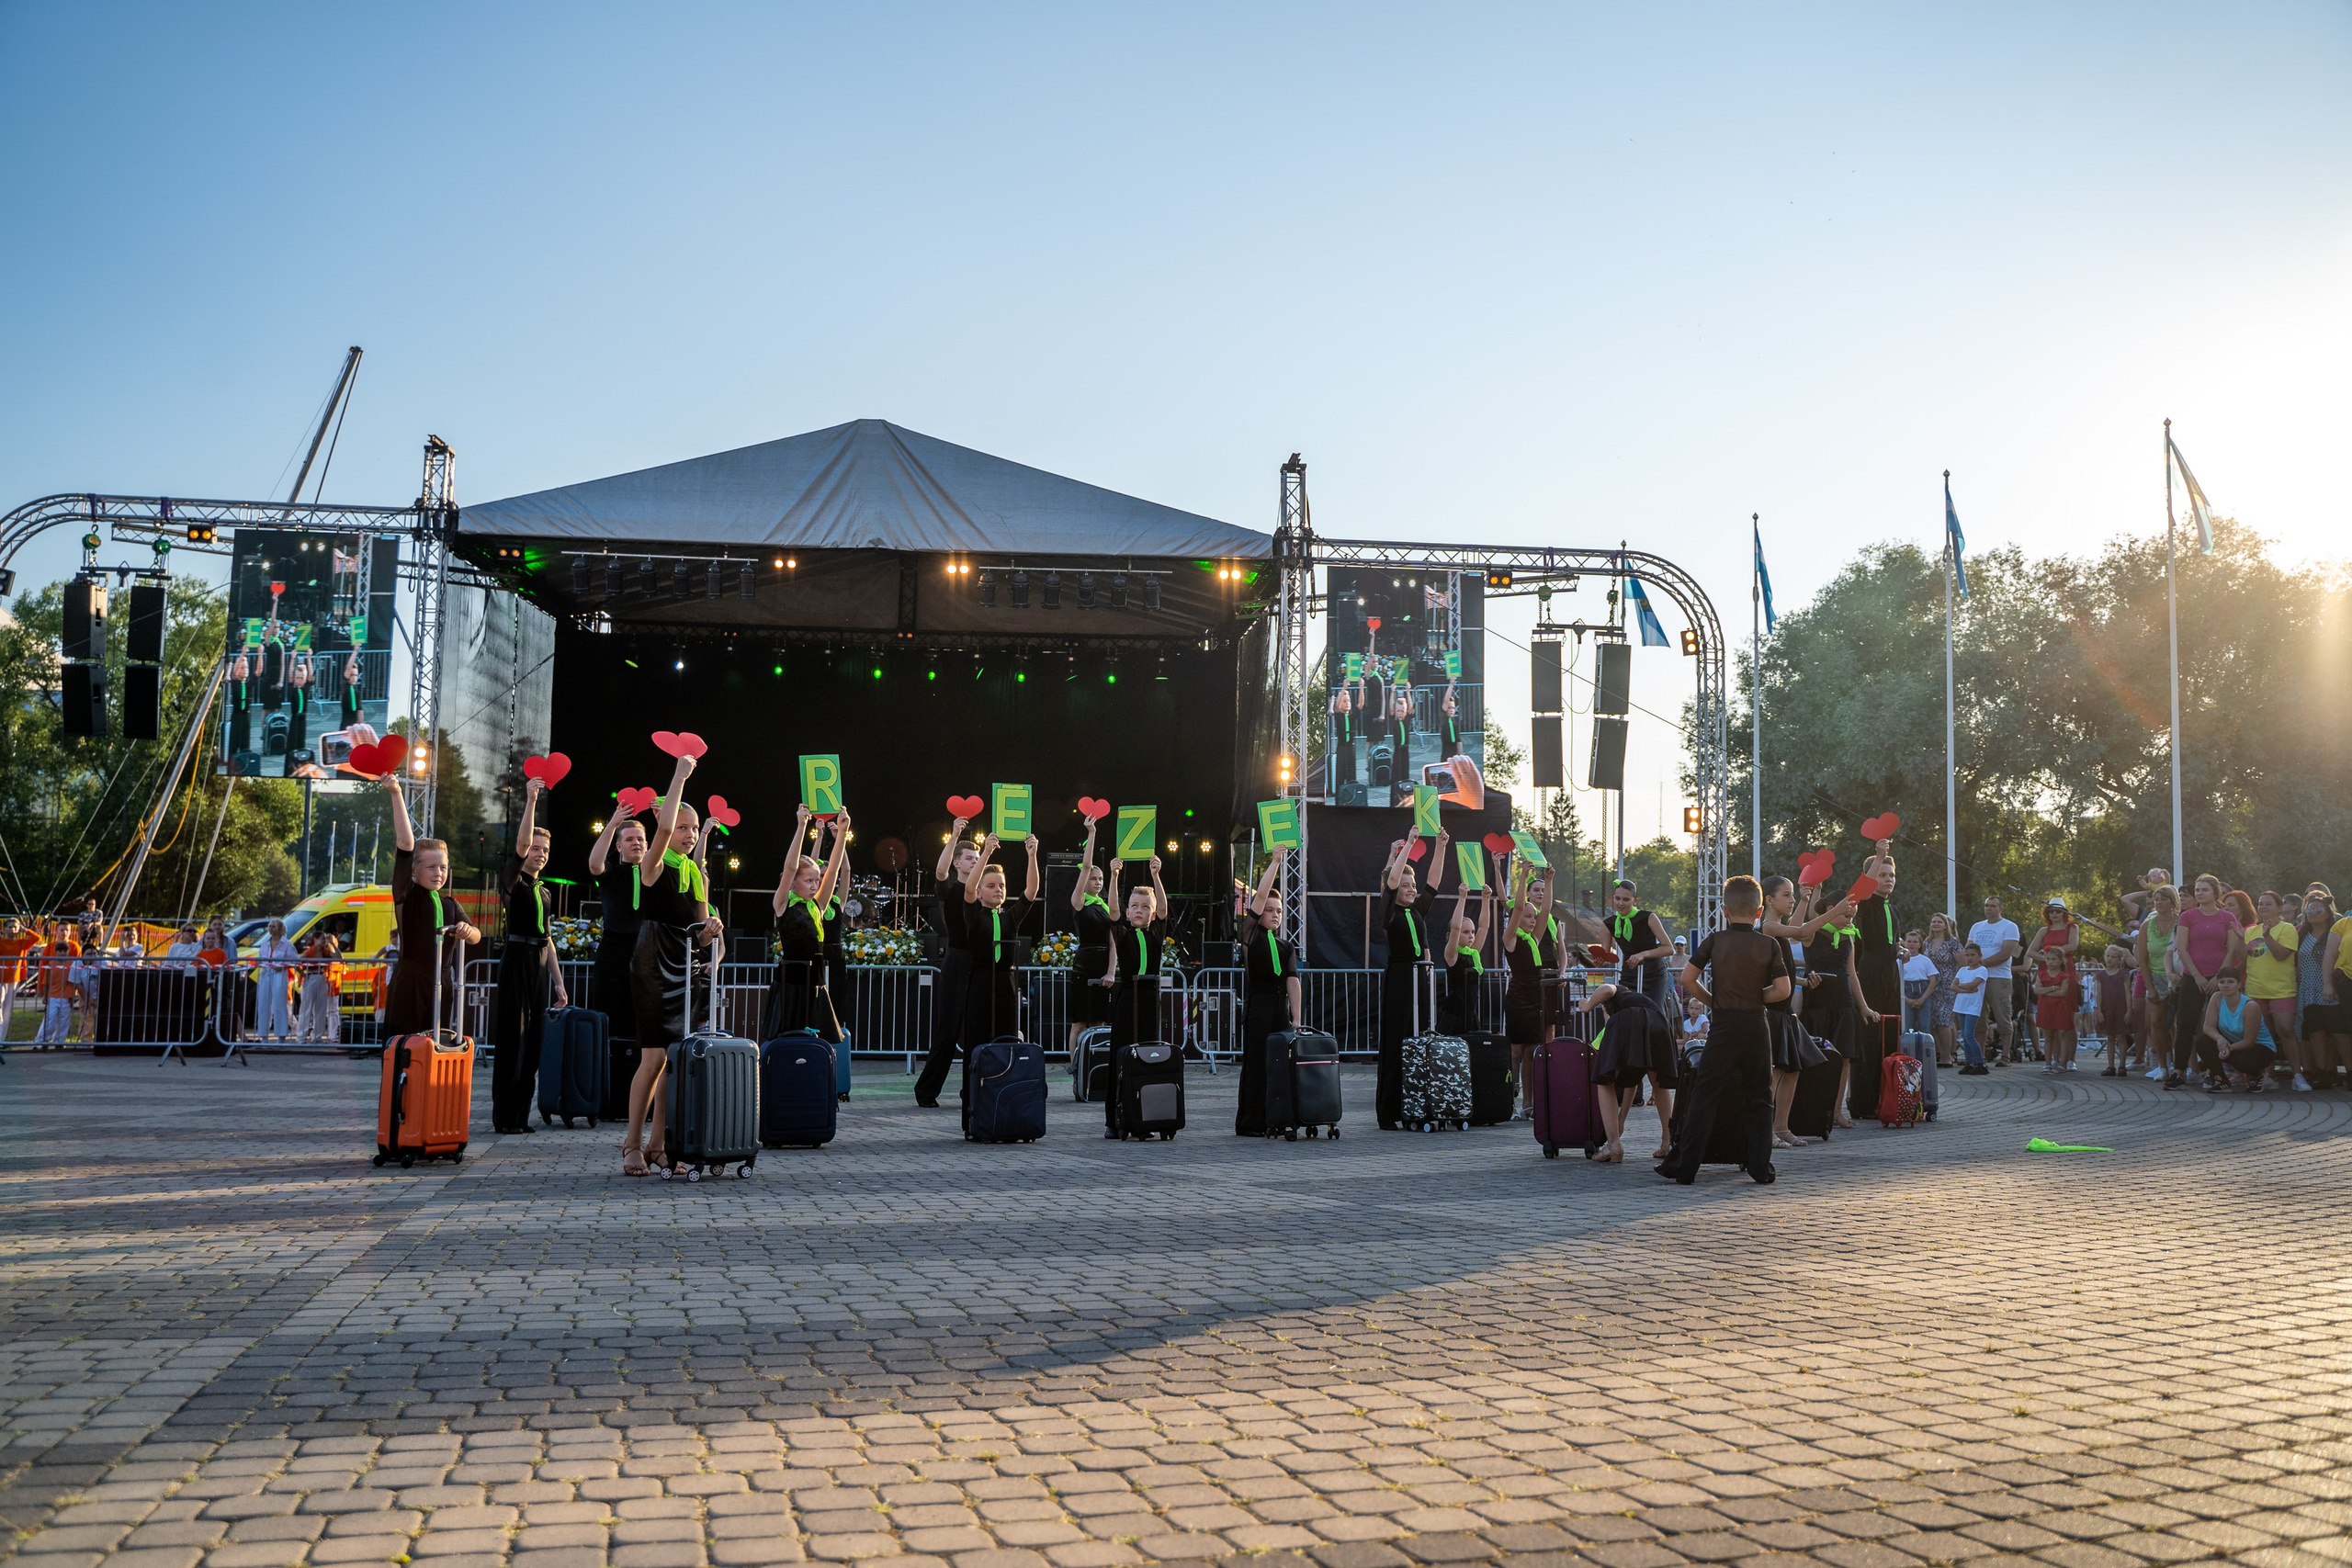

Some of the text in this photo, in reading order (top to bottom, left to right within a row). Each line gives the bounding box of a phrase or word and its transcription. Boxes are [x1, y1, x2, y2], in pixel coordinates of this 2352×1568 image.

[295, 625, 313, 650] Z
[351, 618, 366, 646] E
[1394, 660, 1409, 684] Z
[1445, 653, 1461, 679] E
[805, 759, 842, 811] R
[1117, 808, 1156, 859] Z
[1260, 803, 1297, 851] E
[1415, 787, 1442, 834] K
[1456, 844, 1485, 887] N
[1512, 834, 1548, 866] E
